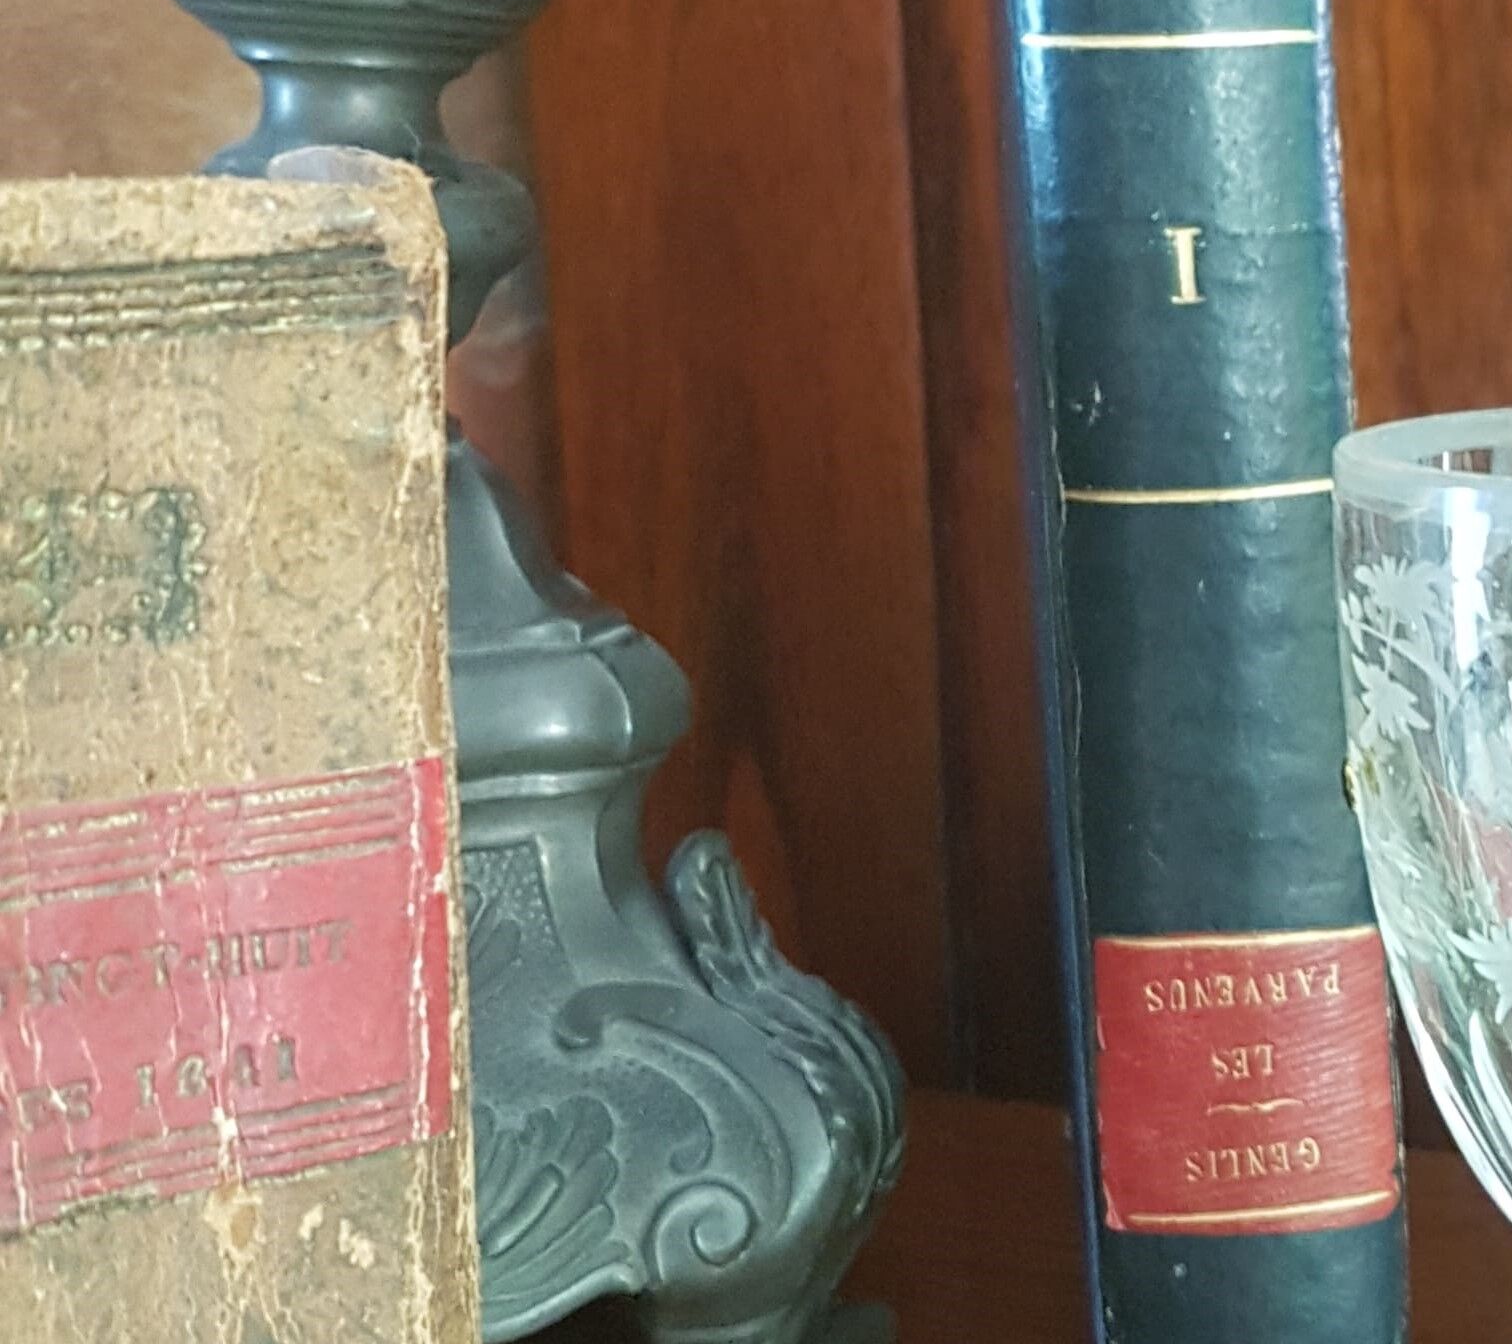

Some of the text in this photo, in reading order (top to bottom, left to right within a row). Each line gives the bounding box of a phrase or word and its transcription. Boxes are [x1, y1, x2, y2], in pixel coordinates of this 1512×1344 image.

[1163, 226, 1206, 305] I
[1144, 962, 1341, 1012] PARVENUS
[1211, 1043, 1275, 1079] LES
[1185, 1136, 1321, 1183] GENLIS
